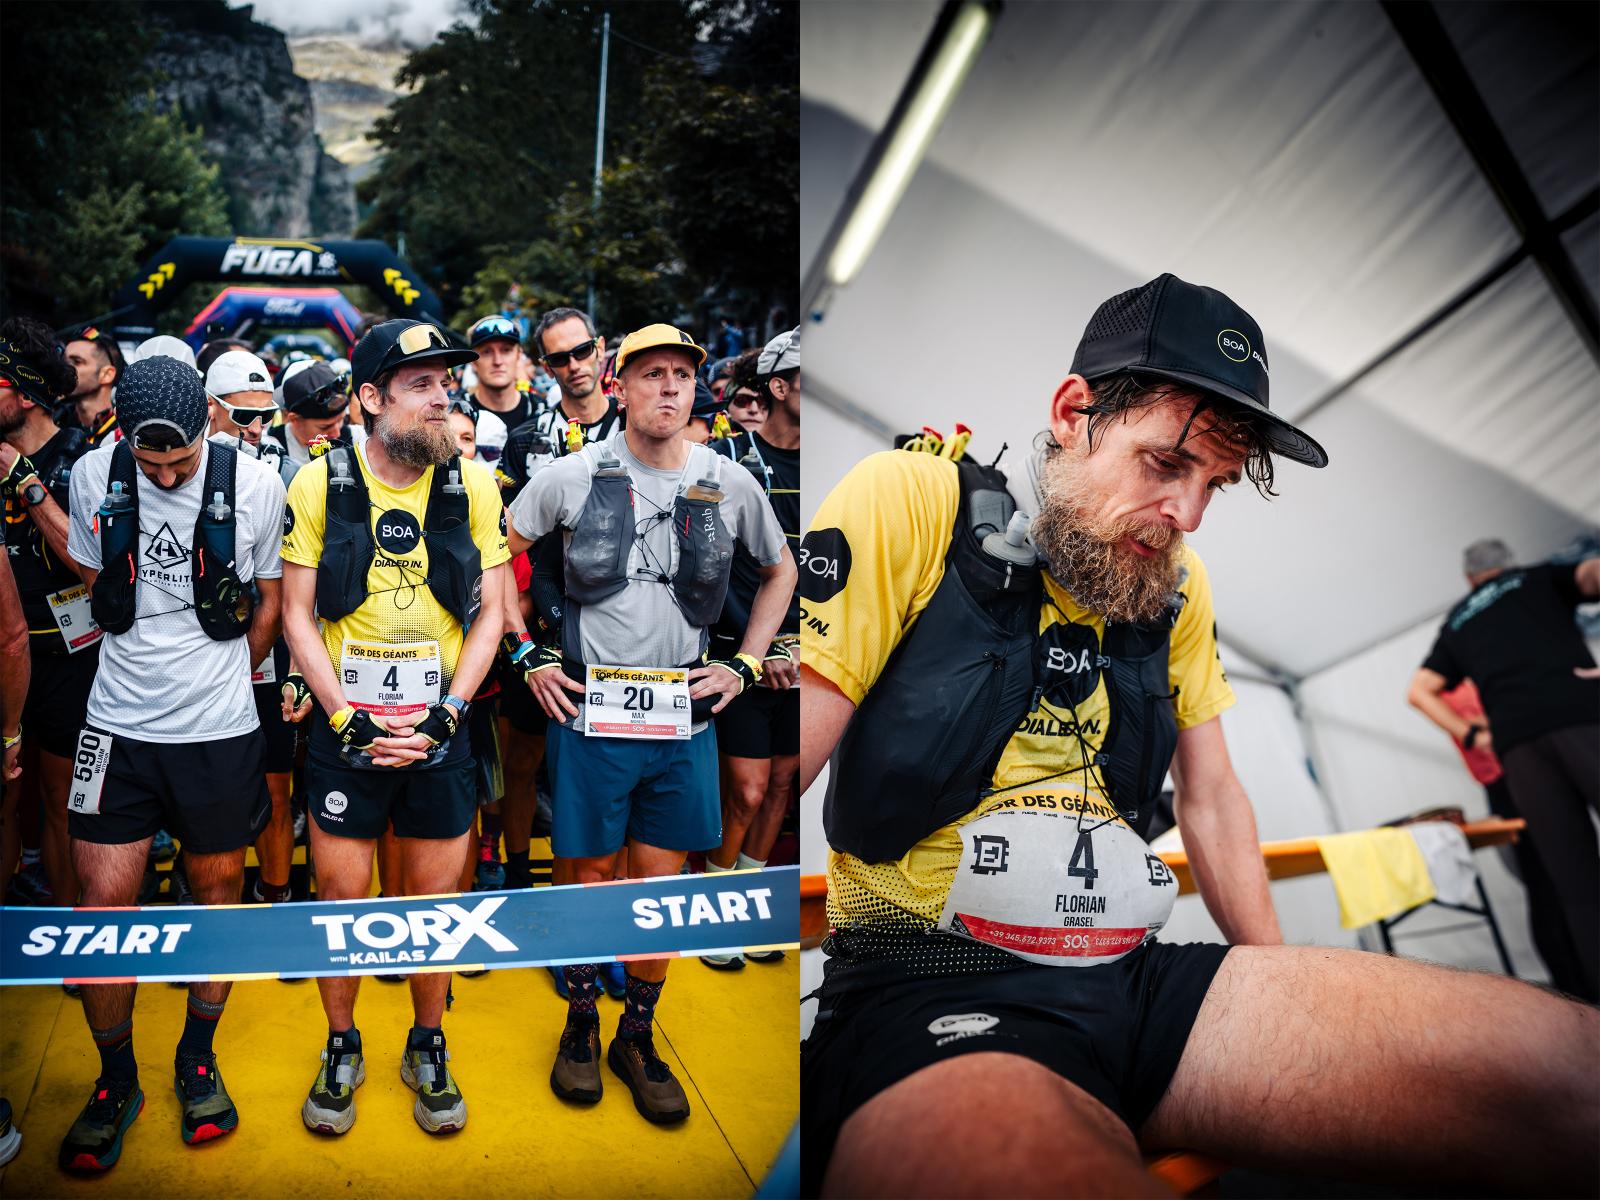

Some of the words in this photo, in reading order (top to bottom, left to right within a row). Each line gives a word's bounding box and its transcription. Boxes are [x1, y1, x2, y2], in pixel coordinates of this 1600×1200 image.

[220, 245, 313, 276] FUGA
[1223, 337, 1245, 353] BOA
[701, 508, 715, 532] Rab
[382, 524, 415, 539] BOA
[374, 559, 409, 568] DIALED
[410, 560, 423, 569] IN.
[141, 569, 194, 583] YPERLIT
[807, 617, 831, 637] IN.
[350, 648, 365, 656] TOR
[366, 650, 381, 658] DES
[382, 649, 417, 659] GÉANTS
[1046, 647, 1092, 674] BOA
[382, 665, 399, 692] 4
[612, 672, 630, 680] DES
[378, 692, 404, 701] FLORIAN
[623, 686, 654, 711] 20
[74, 734, 101, 782] 590
[328, 797, 344, 807] BOA
[1021, 795, 1058, 809] DES
[1067, 829, 1099, 890] 4
[632, 888, 772, 929] START
[1055, 894, 1106, 914] FLORIAN
[311, 896, 520, 961] TORX
[1063, 916, 1095, 928] GRASEL
[21, 923, 193, 956] START
[1062, 934, 1090, 949] SOS
[350, 950, 426, 964] KAILAS
